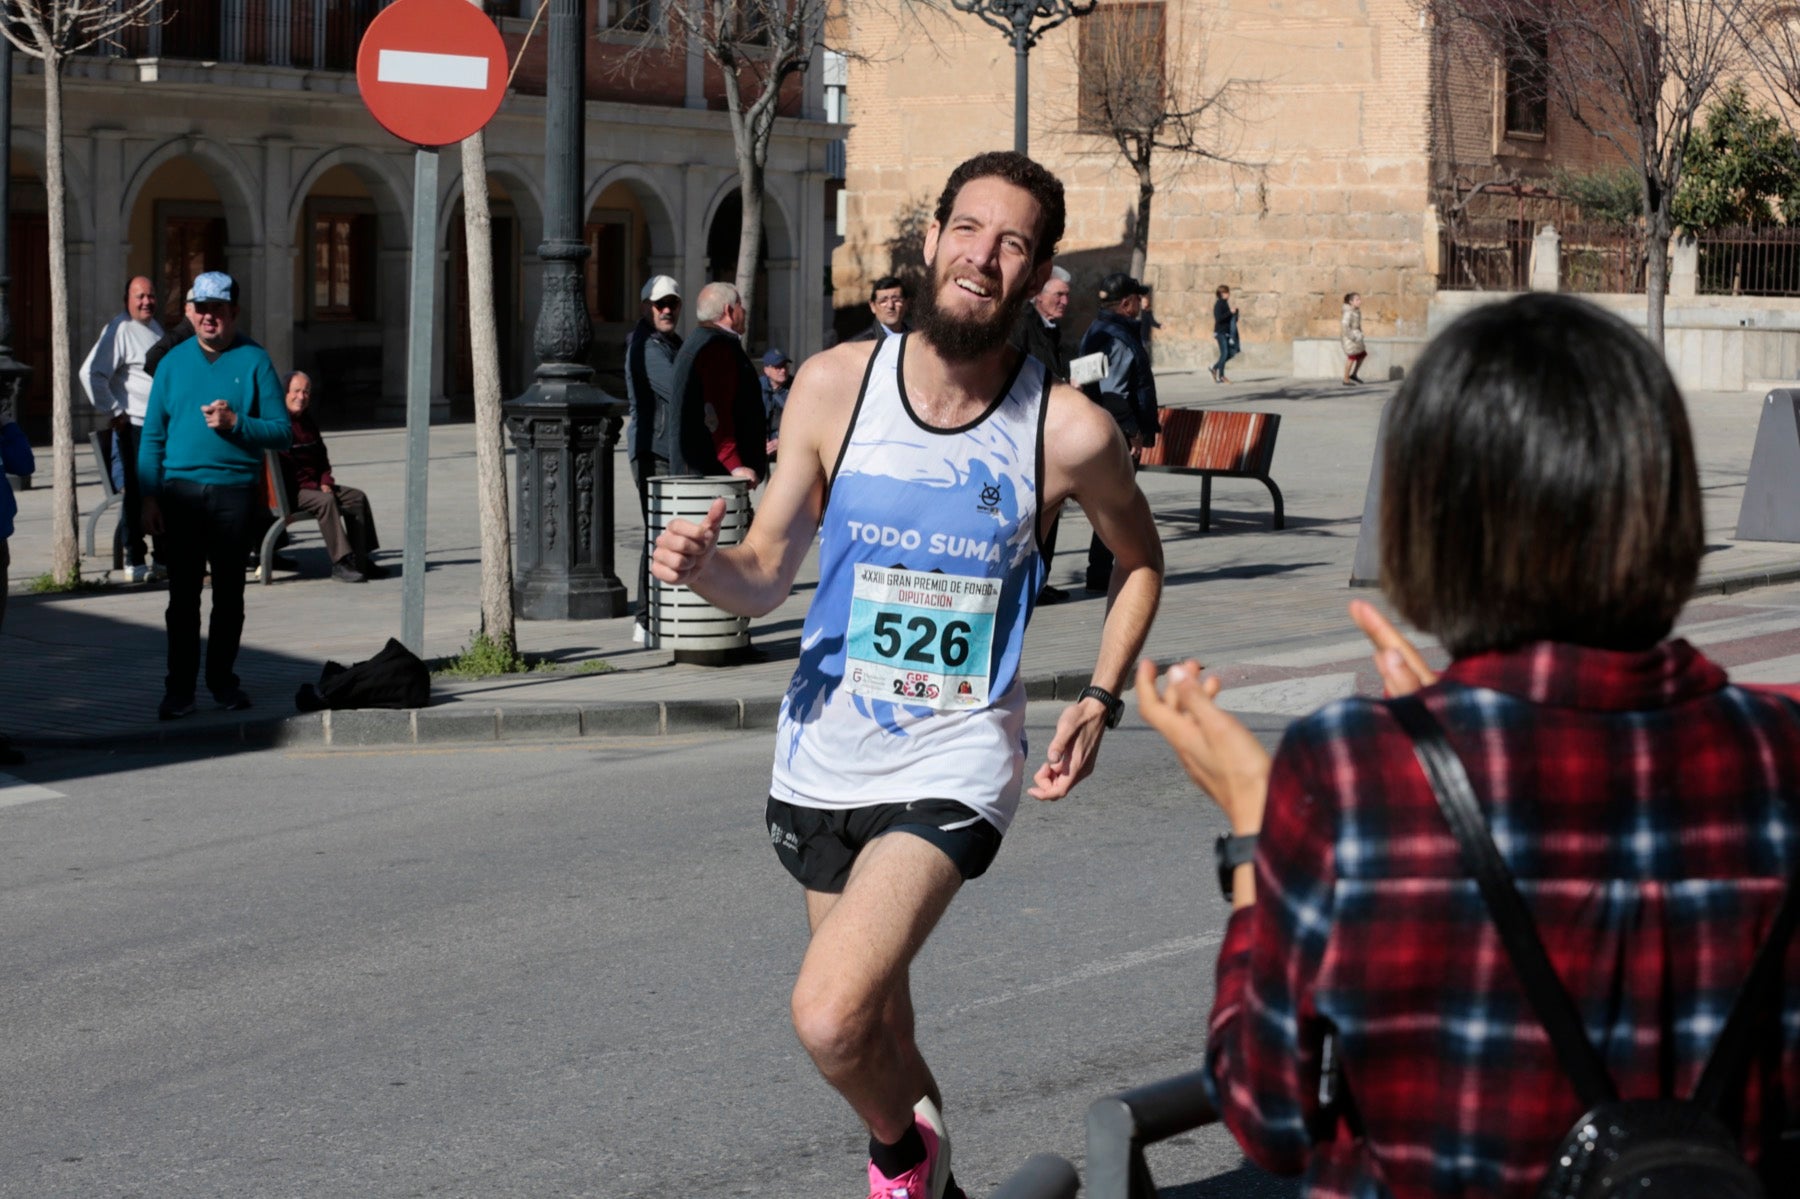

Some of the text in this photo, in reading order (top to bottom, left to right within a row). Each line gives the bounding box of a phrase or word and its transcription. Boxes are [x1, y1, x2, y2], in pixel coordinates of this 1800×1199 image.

[848, 521, 1000, 562] TODO SUMA
[887, 574, 911, 587] GRAN
[914, 577, 947, 592] PREMIO
[950, 581, 961, 594] DE
[964, 583, 993, 596] FONDO
[898, 590, 952, 608] DIPUTACIÓN
[873, 612, 972, 667] 526
